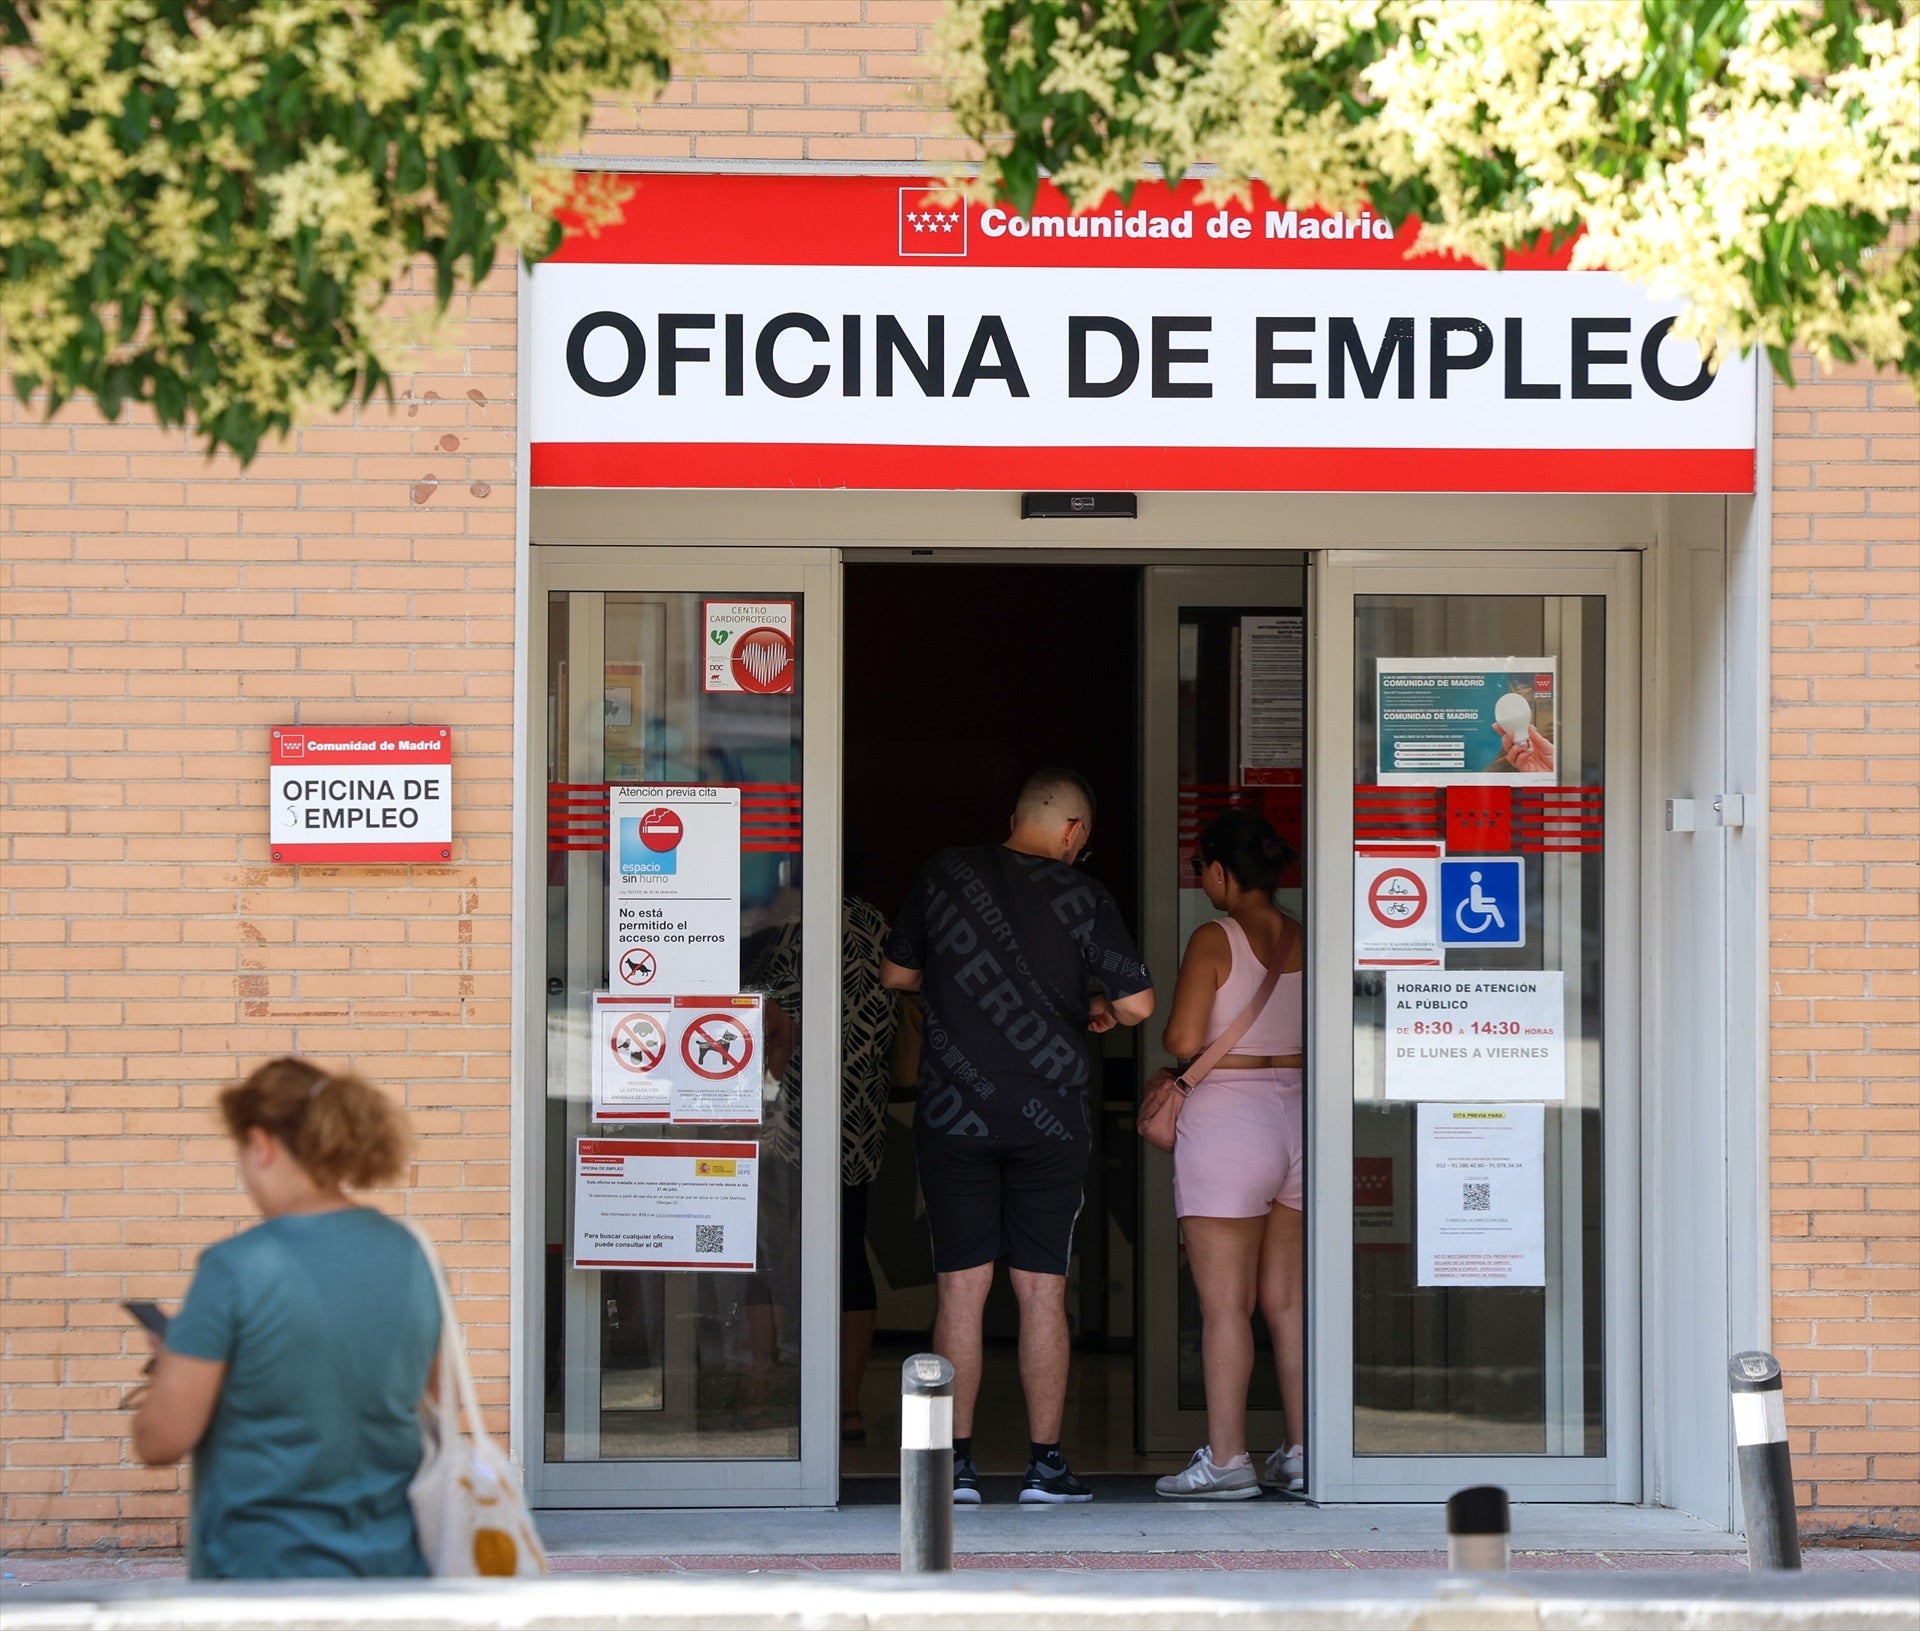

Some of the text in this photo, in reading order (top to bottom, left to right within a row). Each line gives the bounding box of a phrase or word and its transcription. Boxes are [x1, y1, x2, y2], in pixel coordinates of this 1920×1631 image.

[980, 208, 1395, 240] Comunidad de Madrid
[566, 310, 1718, 401] OFICINA DE EMPLEO
[731, 606, 767, 614] CENTRO
[709, 615, 787, 624] CARDIOPROTEGIDO
[306, 740, 441, 751] Comunidad de Madrid
[283, 780, 439, 801] OFICINA DE
[618, 787, 717, 798] Atención previa cita
[305, 807, 419, 829] EMPLEO
[622, 861, 661, 874] espacio
[622, 873, 668, 883] sin humo
[619, 908, 663, 918] No está
[619, 921, 687, 932] permitido el
[619, 935, 725, 944] acceso con perros
[1397, 982, 1536, 993] HORARIO DE ATENCIÓN
[1397, 999, 1468, 1009] AL PÚBLICO
[1414, 1021, 1453, 1035] 8:30
[1470, 1021, 1520, 1035] 14:30
[1397, 1048, 1549, 1058] DE LUNES A VIERNES
[622, 1233, 652, 1241] cualquier
